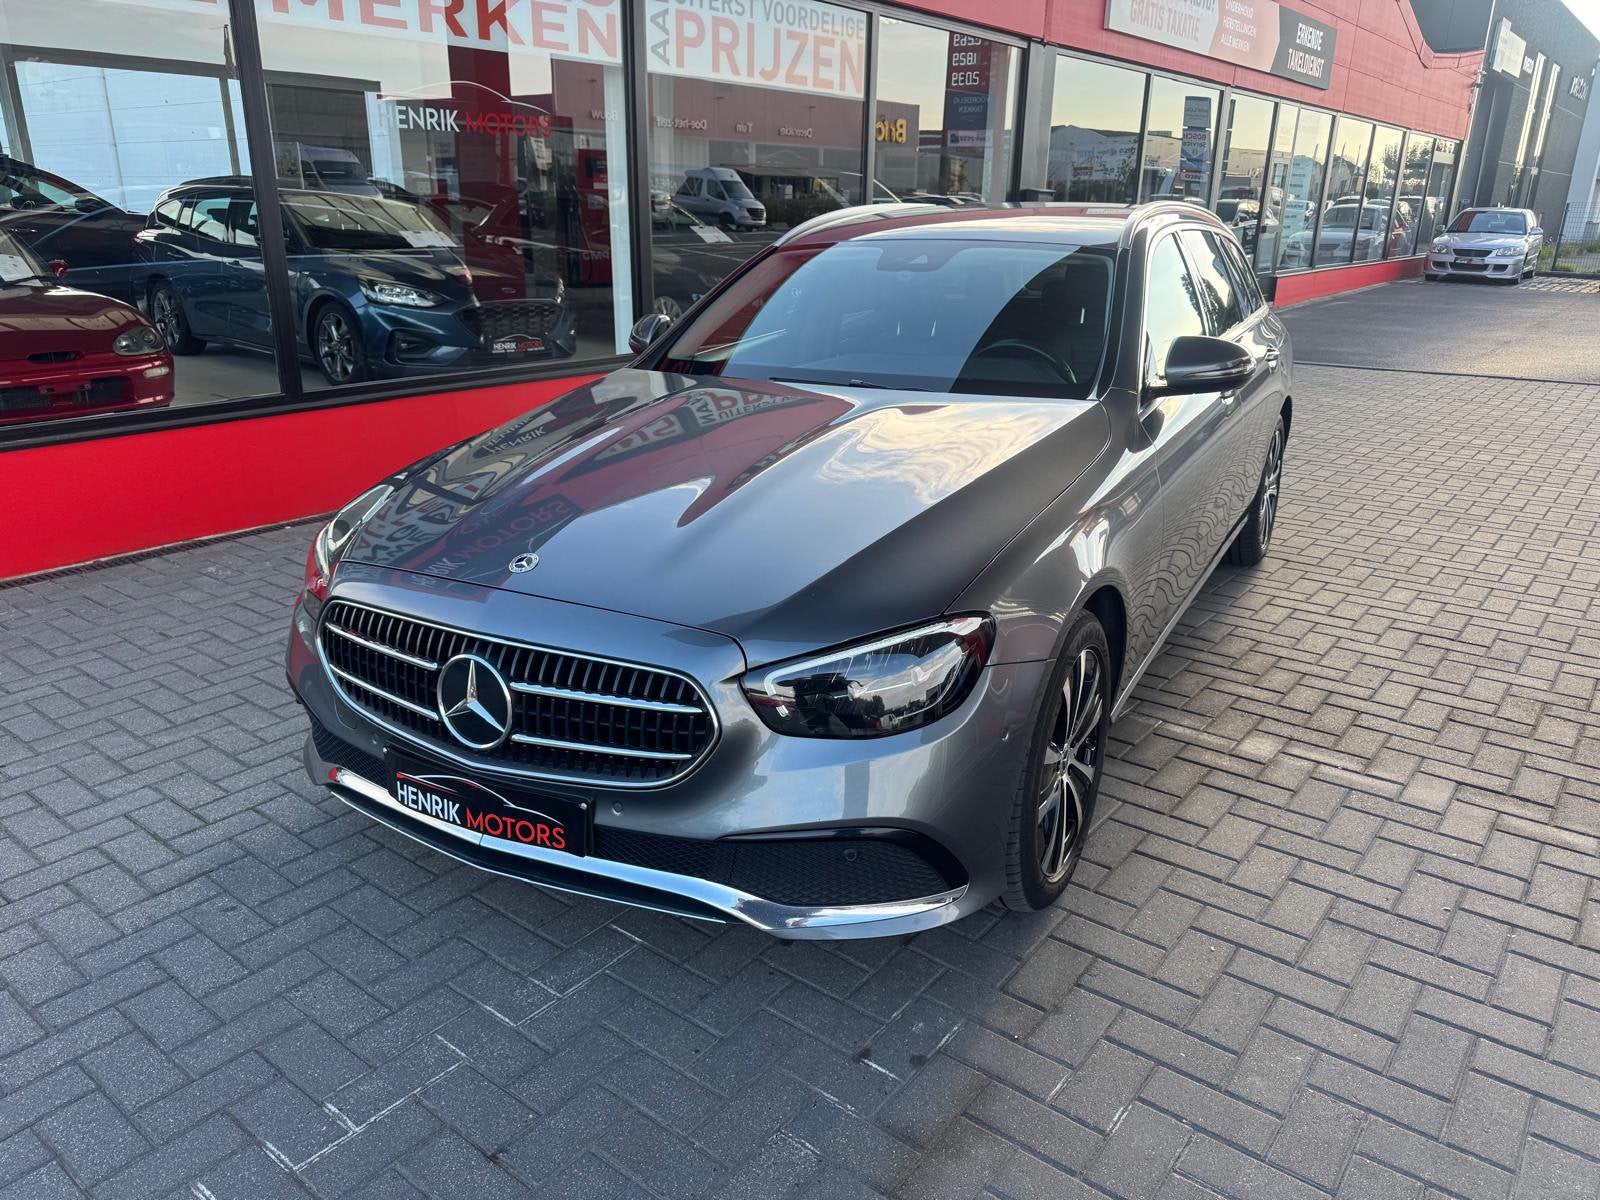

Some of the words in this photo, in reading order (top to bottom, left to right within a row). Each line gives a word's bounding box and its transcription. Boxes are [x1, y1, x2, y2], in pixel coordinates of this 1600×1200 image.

[650, 0, 669, 66] AA
[763, 0, 865, 40] VOORDELIGE
[1130, 0, 1164, 31] GRATIS
[1167, 8, 1200, 42] TAXATIE
[1296, 22, 1324, 51] ERKENDE
[675, 9, 864, 94] PRIJZEN
[1287, 48, 1325, 79] TAKELDIENST
[377, 102, 460, 132] HENRIK
[464, 112, 551, 138] MOTORS
[396, 780, 461, 825] HENRIK
[466, 807, 567, 850] MOTORS
